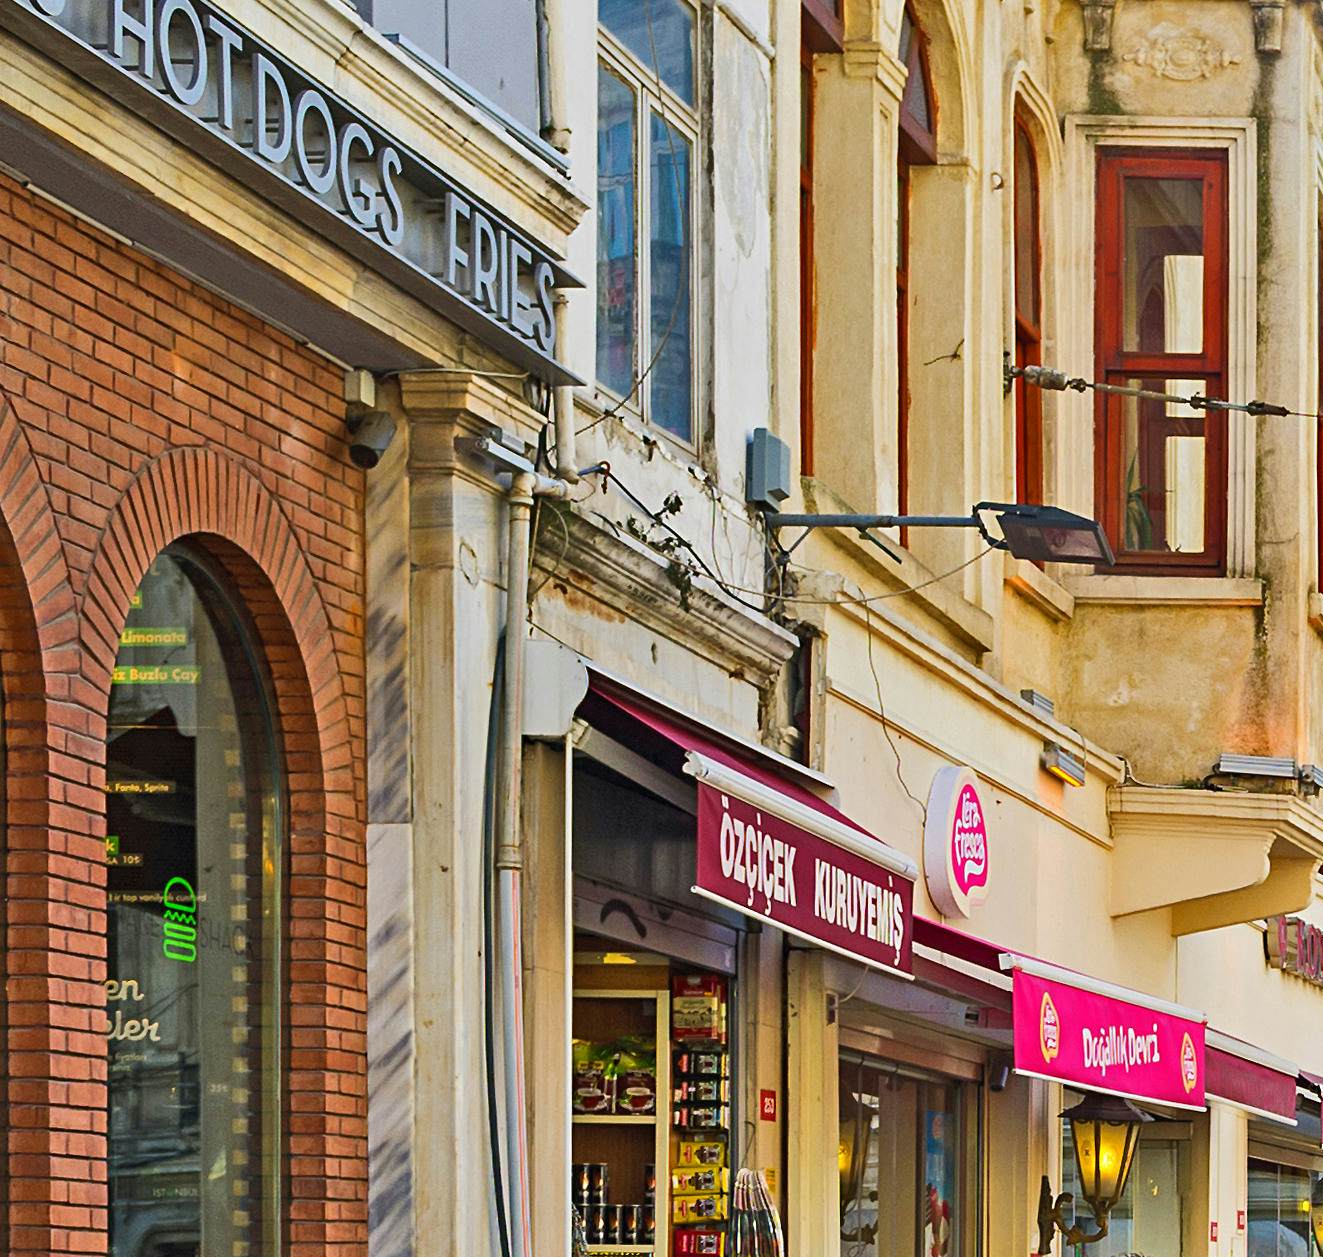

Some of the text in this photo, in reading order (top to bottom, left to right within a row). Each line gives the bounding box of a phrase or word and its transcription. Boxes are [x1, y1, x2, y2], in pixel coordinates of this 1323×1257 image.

[110, 0, 556, 352] HOT DOGS FRIES
[121, 629, 187, 644] Limonata
[172, 669, 200, 684] Çay
[720, 795, 904, 966] ÖZÇİÇEK KURUYEMİŞ
[1128, 1023, 1160, 1066] Devri
